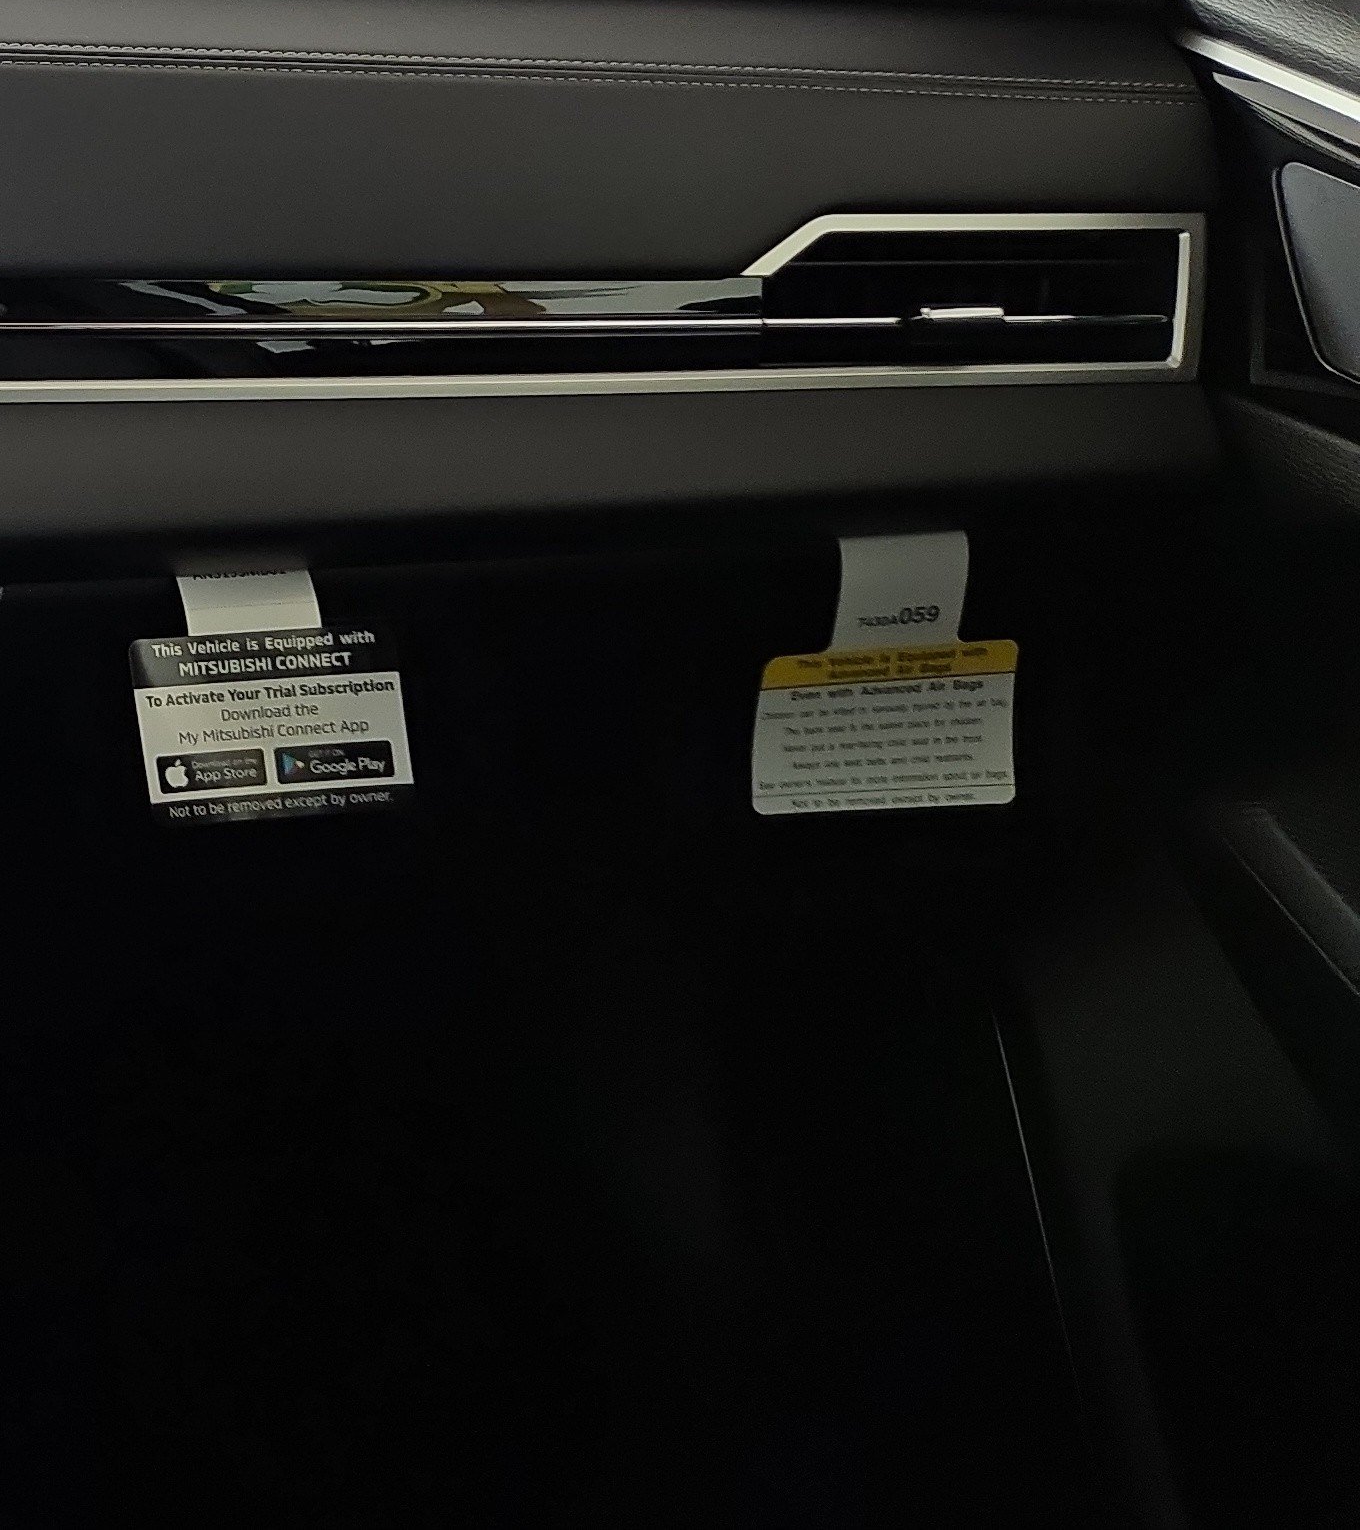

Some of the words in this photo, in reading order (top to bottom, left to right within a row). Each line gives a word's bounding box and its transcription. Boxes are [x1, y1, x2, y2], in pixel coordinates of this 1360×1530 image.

[151, 643, 183, 658] This
[188, 639, 240, 656] Vehicle
[246, 638, 259, 651] is
[265, 633, 334, 651] Equipped
[338, 630, 376, 644] with
[178, 657, 273, 677] MITSUBISHI
[275, 651, 352, 670] CONNECT
[146, 694, 163, 708] To
[165, 690, 225, 708] Activate
[228, 687, 261, 703] Your
[263, 684, 297, 700] Trial
[299, 678, 395, 699] Subscription
[221, 703, 293, 722] Download
[294, 702, 319, 717] the
[178, 731, 199, 747] My
[202, 723, 275, 744] Mitsubishi
[277, 721, 336, 739] Connect
[340, 719, 370, 736] App
[194, 768, 223, 783] App
[224, 766, 258, 779] Store
[309, 759, 357, 776] Google
[357, 756, 386, 773] Play
[169, 805, 191, 819] Not
[193, 803, 207, 816] to
[208, 801, 225, 815] be
[228, 795, 282, 813] removed
[284, 795, 328, 811] except
[330, 792, 347, 807] by
